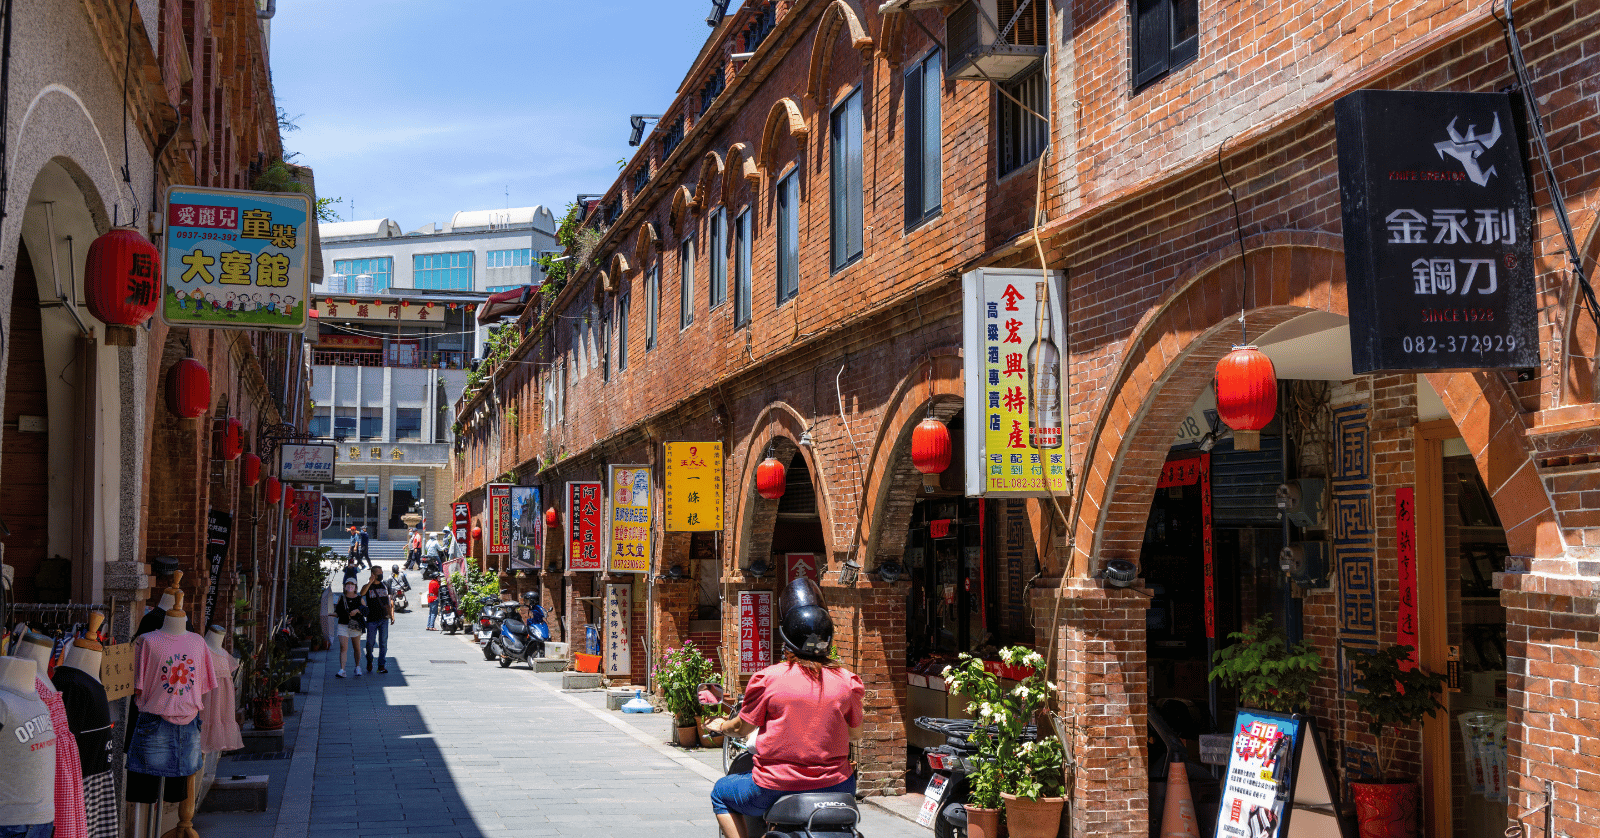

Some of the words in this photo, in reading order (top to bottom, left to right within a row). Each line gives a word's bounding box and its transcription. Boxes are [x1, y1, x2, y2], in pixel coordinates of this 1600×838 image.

[1388, 170, 1418, 181] KNIFE
[1419, 170, 1466, 182] CREATOR
[177, 206, 237, 228] 愛麗兒
[1385, 208, 1517, 245] 金永利
[176, 230, 238, 242] 0937-392-392
[241, 209, 297, 249] 童裝
[181, 249, 290, 288] 大童館
[1411, 257, 1498, 295] 鋼刀
[1421, 308, 1460, 322] SINCE
[1462, 308, 1494, 322] 1928
[1402, 335, 1516, 353] 082-372929
[987, 301, 1001, 432] 高粱酒專賣店
[1001, 283, 1027, 449] 金宏興特產
[990, 453, 1063, 465] 宅配到家
[990, 465, 1064, 476] 貨到付款
[687, 476, 701, 526] 一條根
[615, 543, 645, 557] 惠文堂
[1250, 721, 1277, 740] 618
